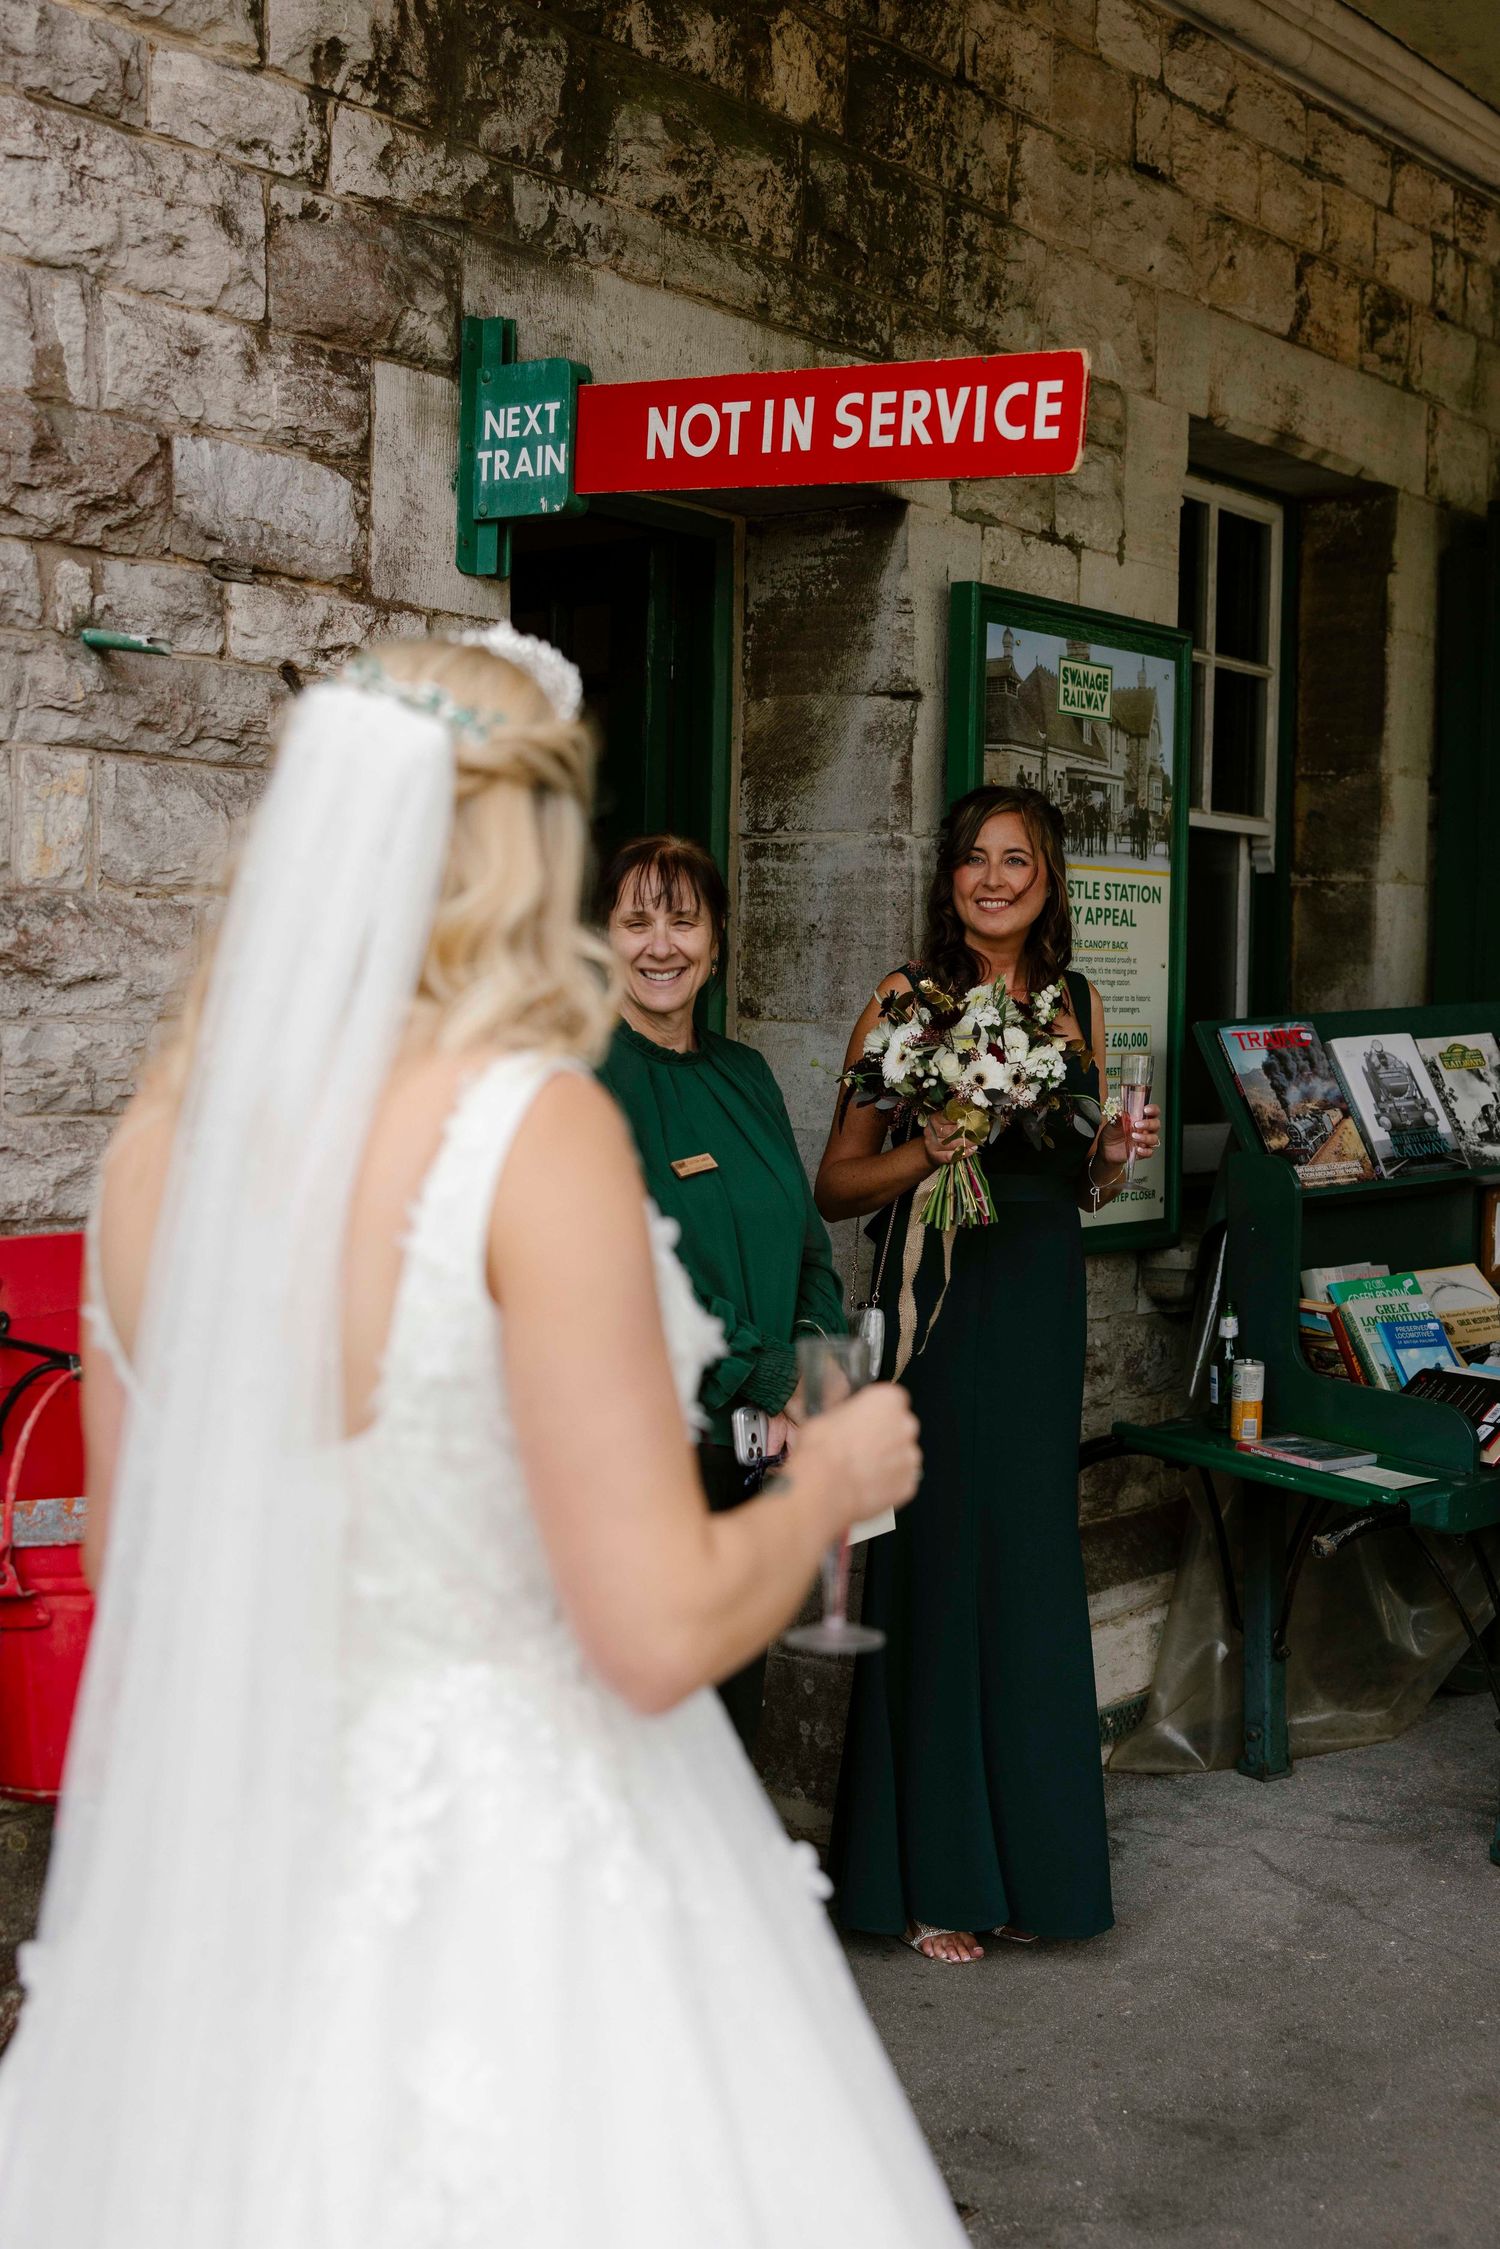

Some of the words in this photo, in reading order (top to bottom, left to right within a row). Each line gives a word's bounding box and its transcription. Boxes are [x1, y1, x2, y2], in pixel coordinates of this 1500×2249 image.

[483, 402, 562, 440] NEXT
[646, 400, 751, 460] NOT
[761, 397, 815, 453] IN
[833, 380, 1064, 449] SERVICE
[478, 443, 566, 482] TRAIN
[1062, 667, 1109, 692] SWANAGE
[1063, 688, 1107, 712] RAILWAY
[1067, 880, 1100, 900] STLE
[1104, 883, 1161, 904] STATION
[1084, 907, 1137, 927] APPEAL
[1084, 940, 1110, 949] CANOPY
[1112, 941, 1129, 950] BACK
[1112, 1032, 1148, 1050] £60,000
[1232, 1029, 1310, 1050] TRAINS
[1392, 1141, 1451, 1158] RAILWAYS
[1130, 1189, 1156, 1201] CLOSER
[1360, 1311, 1436, 1327] LOCOMOTIVES
[1376, 1303, 1410, 1315] GREAT
[1395, 1331, 1435, 1340] LOCOMOTIVES
